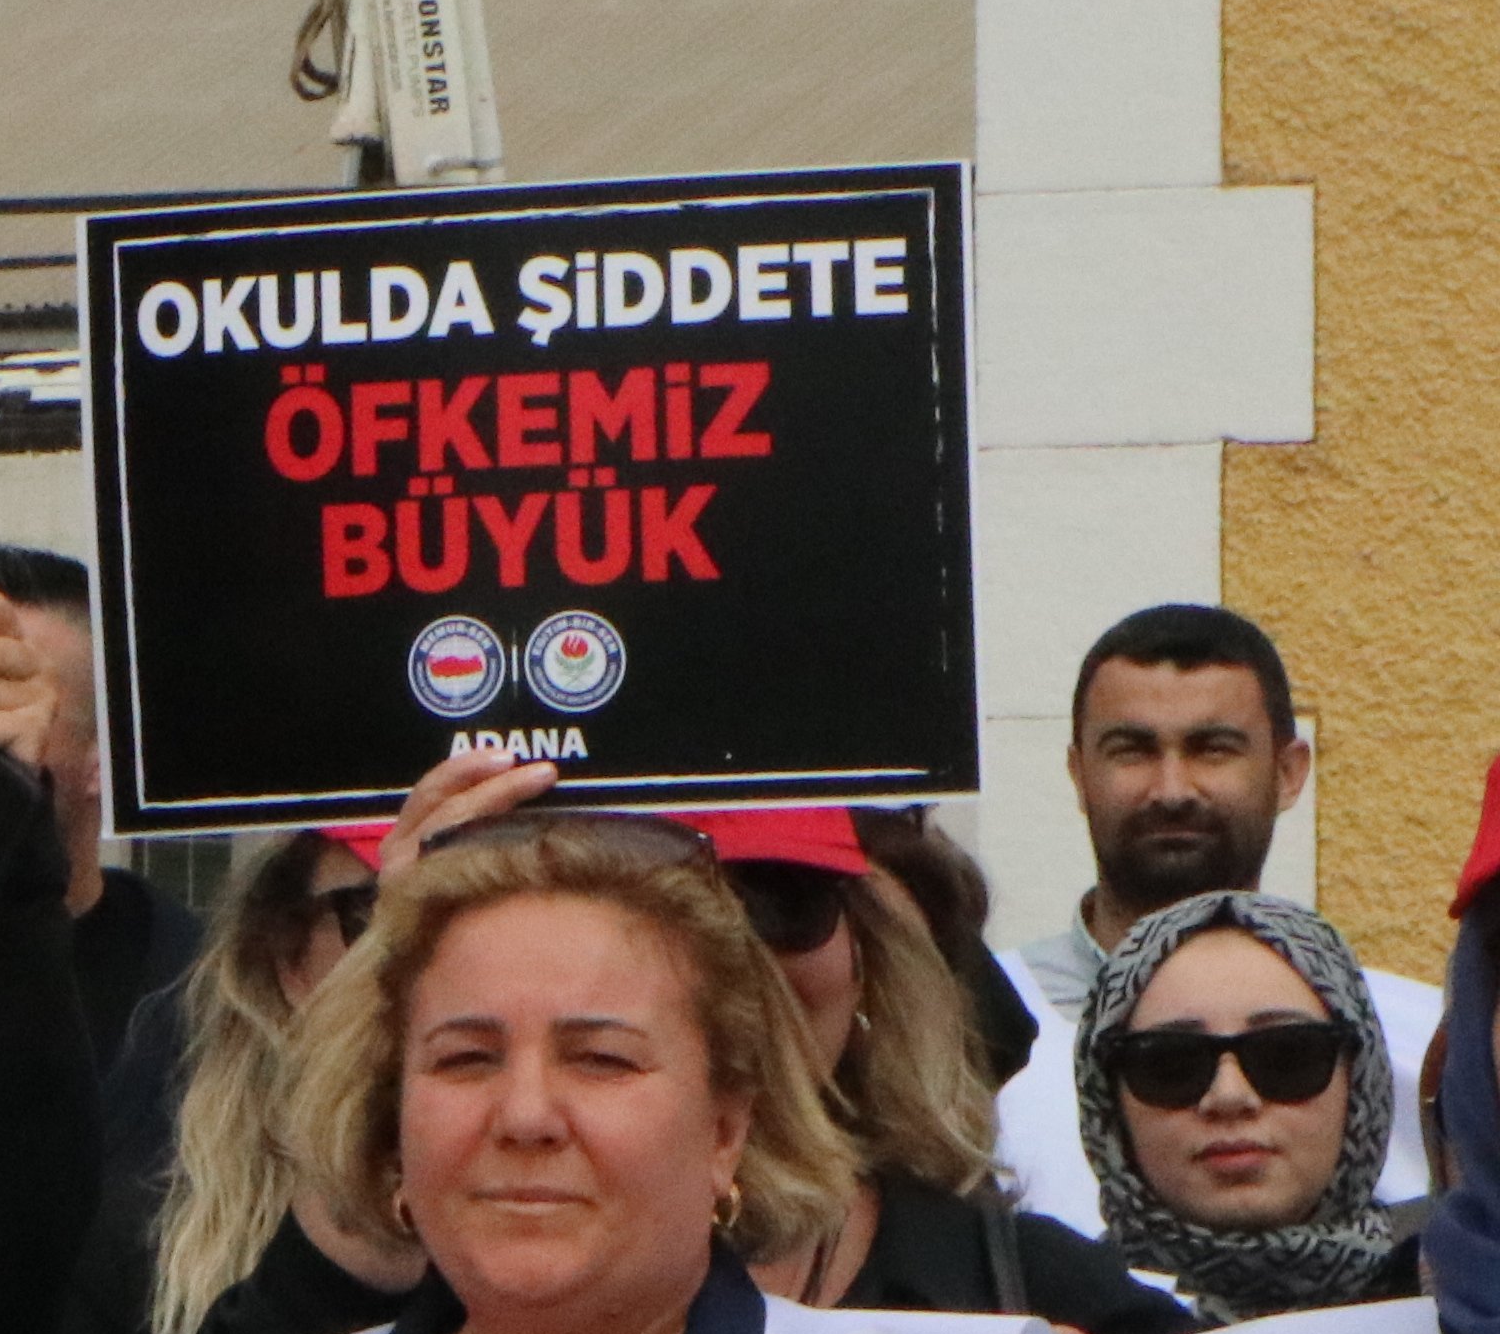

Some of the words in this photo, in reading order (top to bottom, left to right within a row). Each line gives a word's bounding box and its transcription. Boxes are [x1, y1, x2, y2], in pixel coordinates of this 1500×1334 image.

[137, 261, 493, 358] OKULDA
[516, 237, 909, 346] ŞİDDETE
[264, 360, 772, 482] ÖFKEMİZ
[321, 469, 720, 599] BÜYÜK
